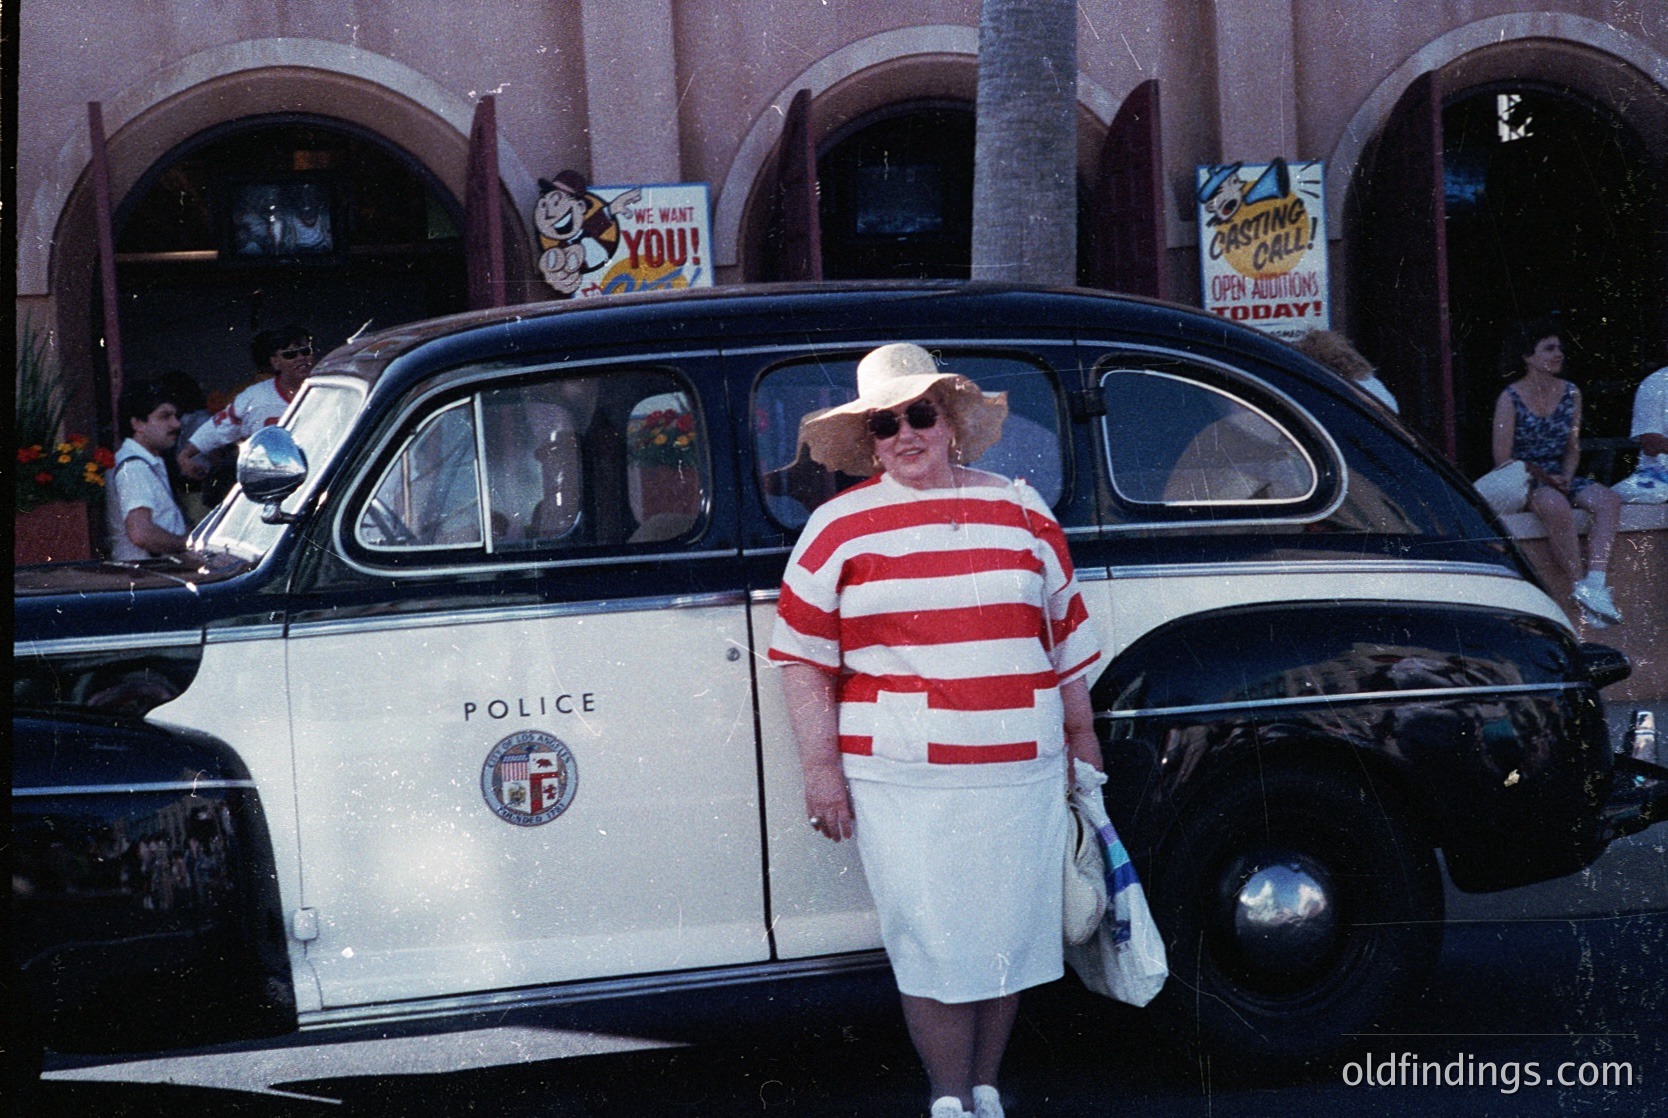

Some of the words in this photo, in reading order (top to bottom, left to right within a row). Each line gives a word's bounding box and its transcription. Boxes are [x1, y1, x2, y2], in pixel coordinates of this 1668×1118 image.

[634, 207, 653, 224] WE
[659, 206, 694, 223] WANT
[1209, 198, 1305, 260] CASTING
[621, 226, 701, 269] YOU!
[1253, 216, 1318, 271] CALL!
[1211, 274, 1247, 302] OPEN
[1251, 271, 1319, 300] AUDITIONS
[1210, 300, 1323, 321] TODAY!
[464, 692, 595, 721] POLICE
[515, 733, 535, 744] LOS
